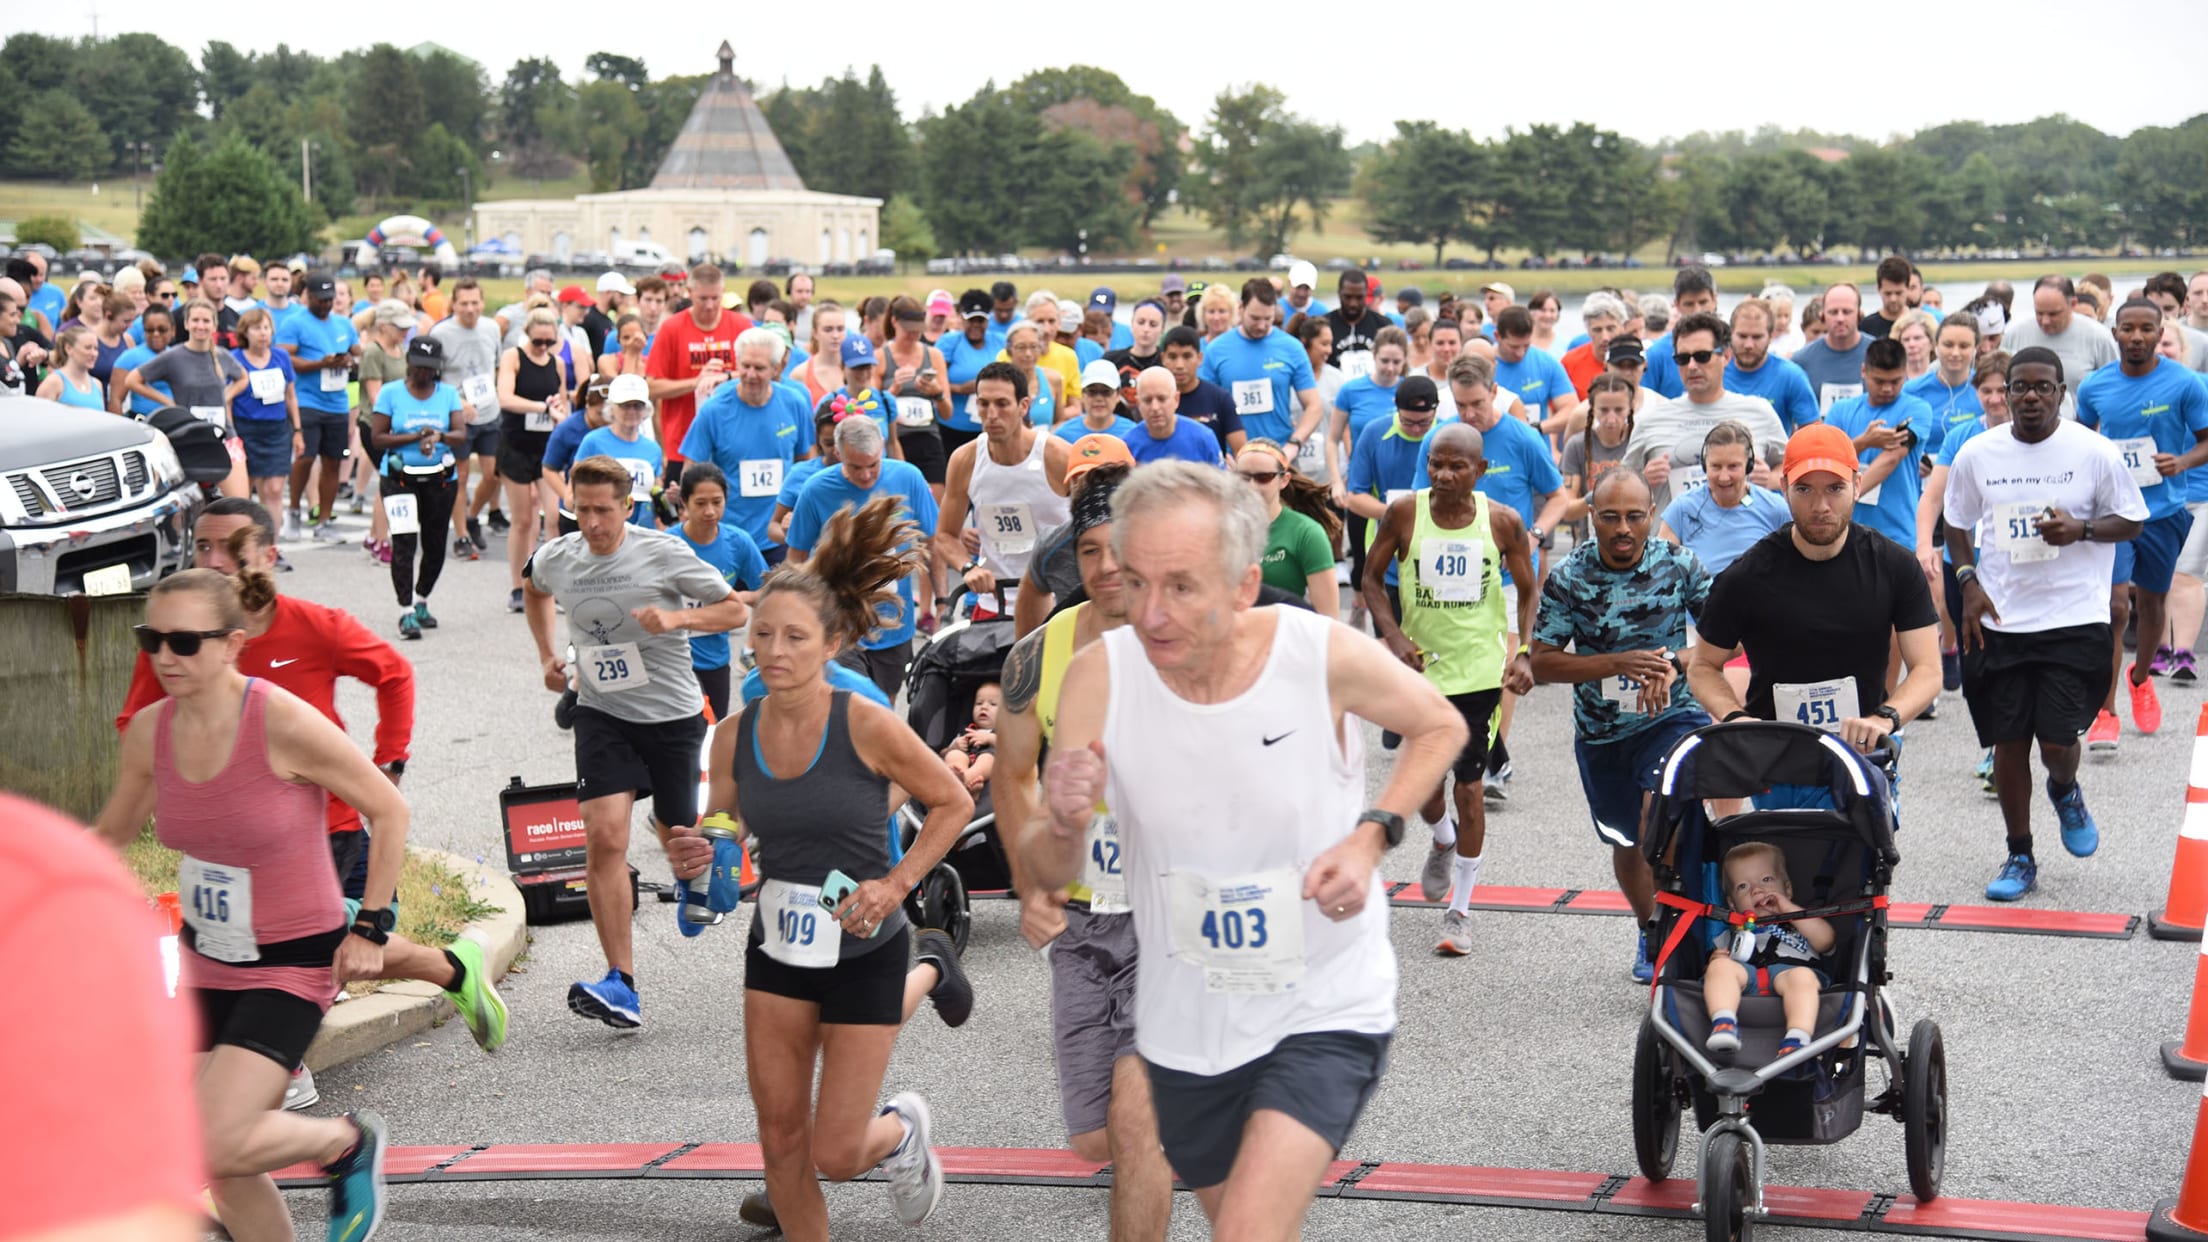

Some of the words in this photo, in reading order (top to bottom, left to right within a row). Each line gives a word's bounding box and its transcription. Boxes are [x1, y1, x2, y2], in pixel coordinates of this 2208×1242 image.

[1242, 391, 1262, 406] 361
[752, 471, 773, 487] 142
[1986, 477, 2008, 487] back
[2026, 476, 2041, 485] my
[994, 515, 1022, 532] 398
[1435, 554, 1467, 577] 430
[594, 658, 629, 681] 239
[1796, 699, 1840, 725] 451
[1092, 839, 1122, 875] 42
[194, 885, 229, 923] 416
[1201, 907, 1268, 950] 403
